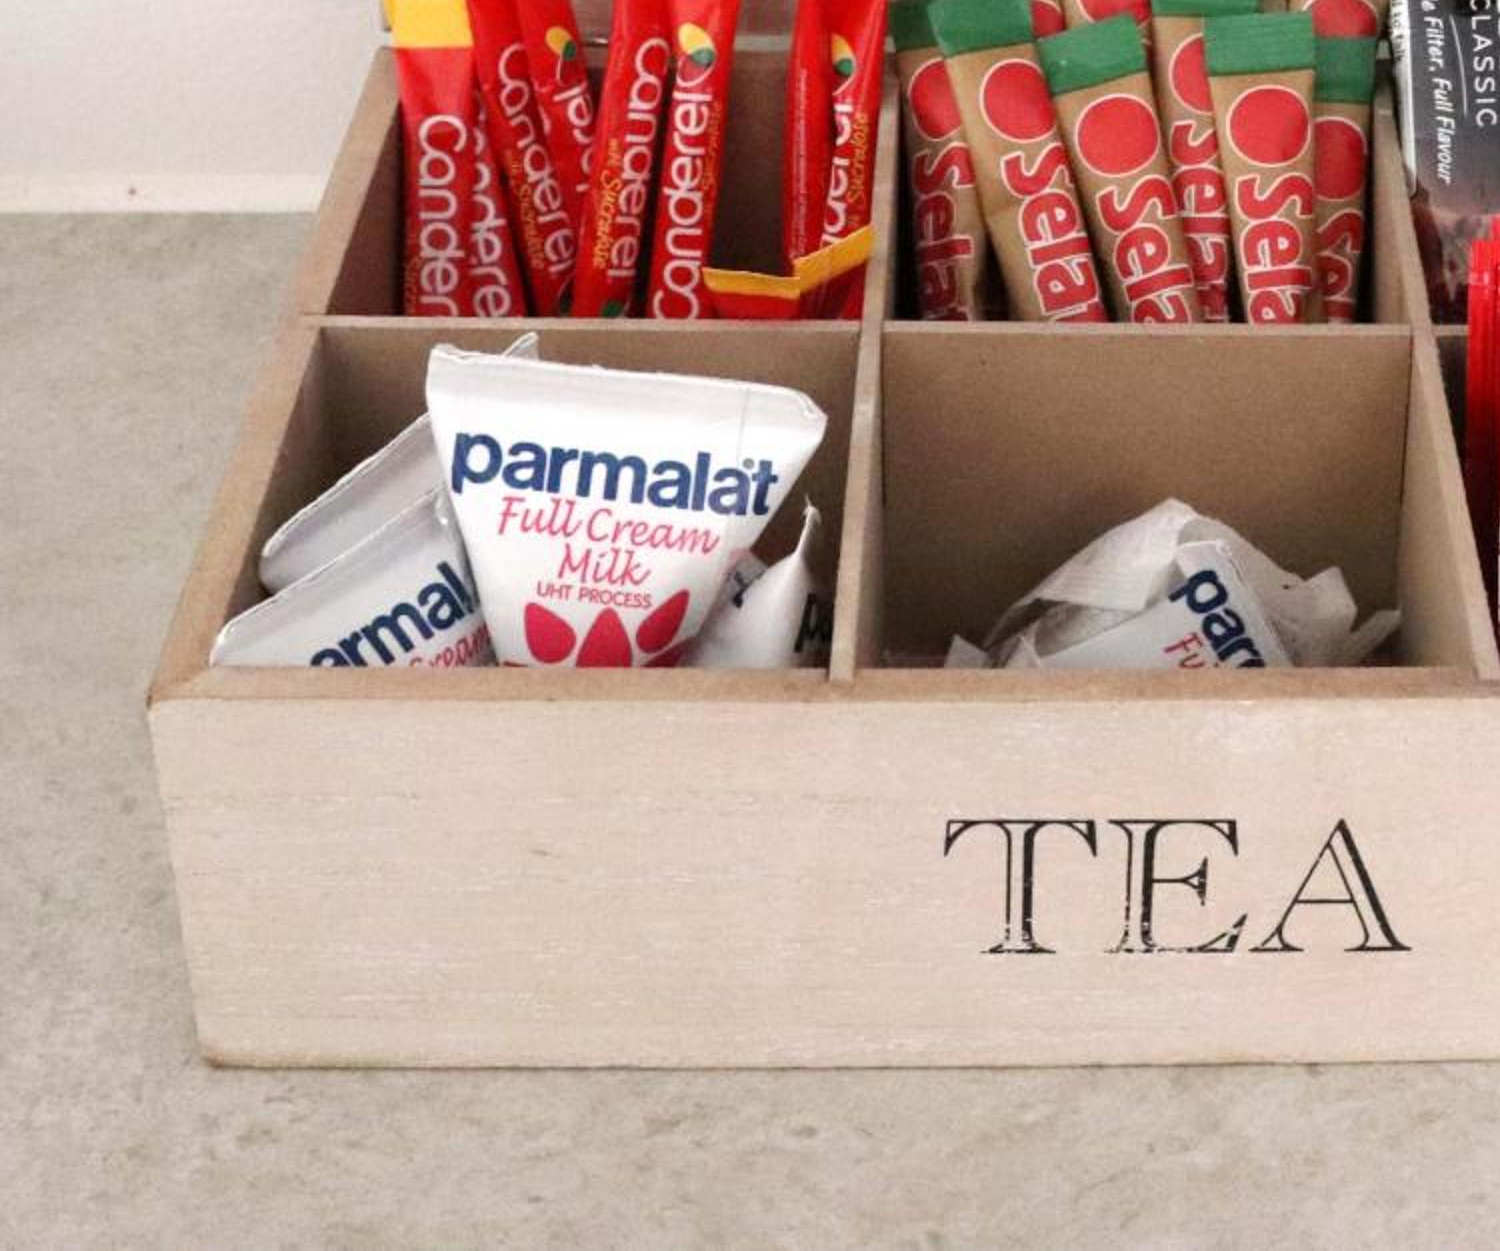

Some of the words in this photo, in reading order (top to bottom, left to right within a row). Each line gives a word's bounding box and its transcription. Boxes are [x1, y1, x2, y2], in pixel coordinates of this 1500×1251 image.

[1433, 77, 1453, 121] Full
[1436, 115, 1456, 185] Flavour
[451, 432, 778, 517] parmalat
[497, 495, 583, 536] Full
[587, 507, 722, 555] Cream
[537, 583, 573, 602] UHT
[577, 584, 655, 610] PROCESS
[557, 545, 654, 588] Milk
[943, 817, 1412, 954] TEA
